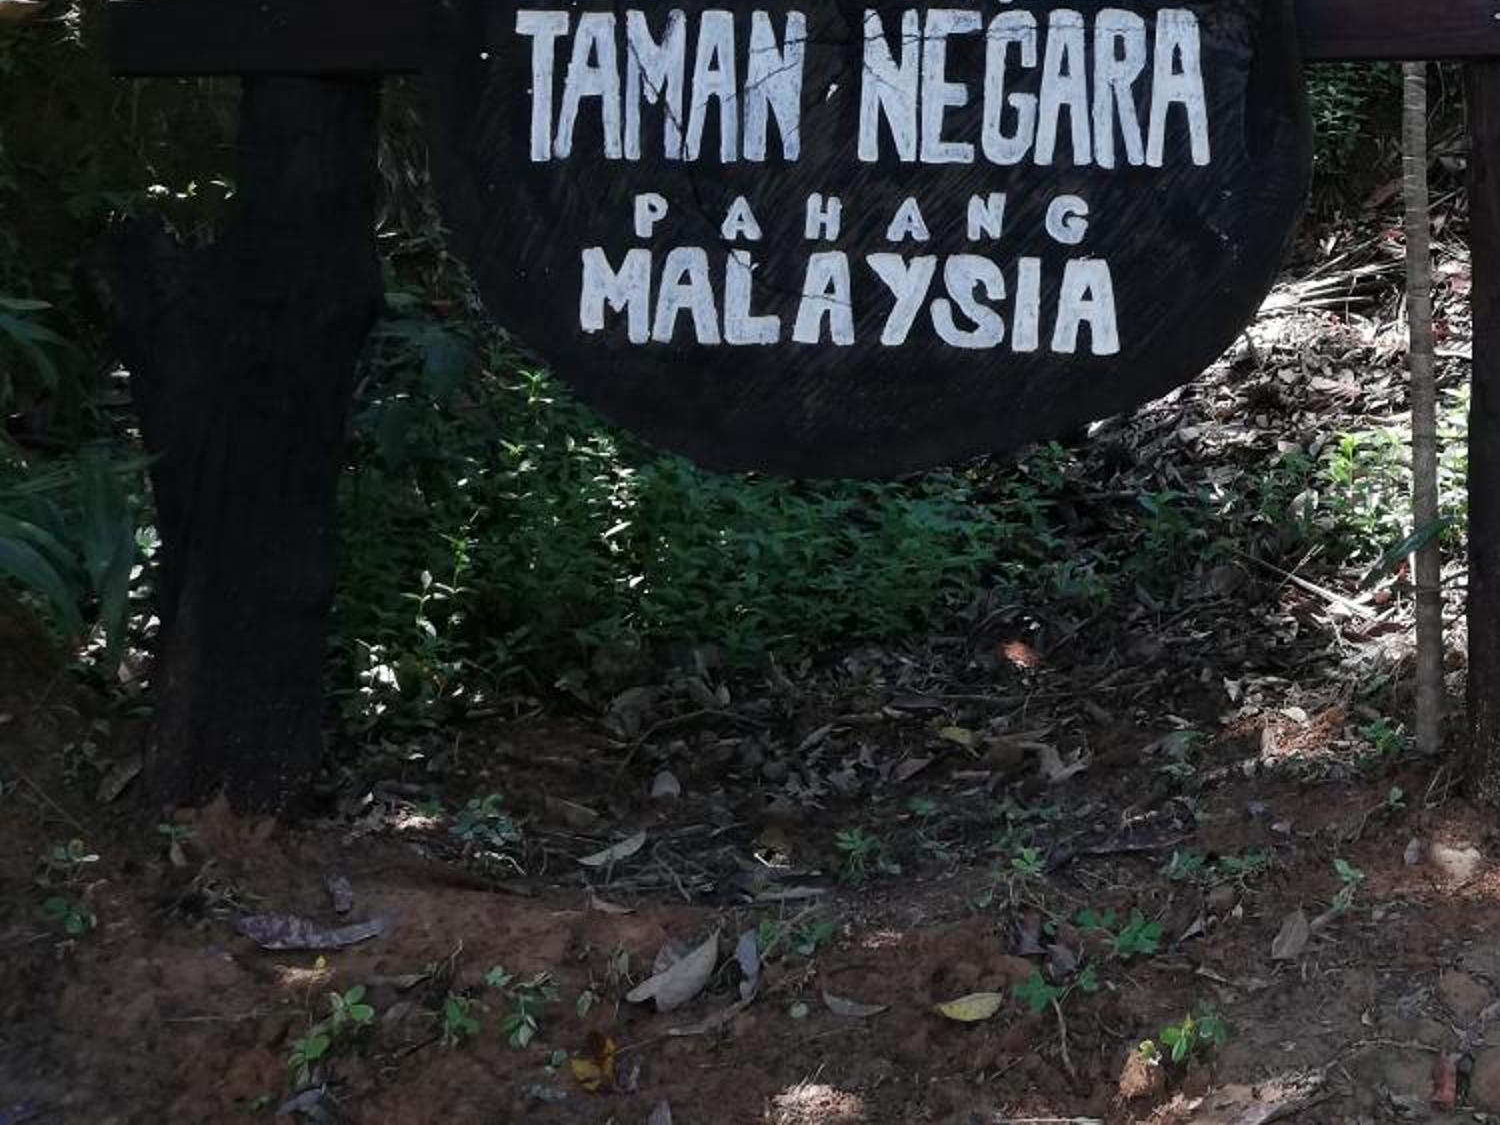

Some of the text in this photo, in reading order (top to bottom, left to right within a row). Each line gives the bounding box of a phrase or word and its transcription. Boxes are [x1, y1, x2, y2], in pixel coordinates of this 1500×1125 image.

[515, 8, 1211, 169] TAMAN NEGARA
[634, 192, 1089, 245] PAHANG
[579, 246, 1121, 356] MALAYSIA
